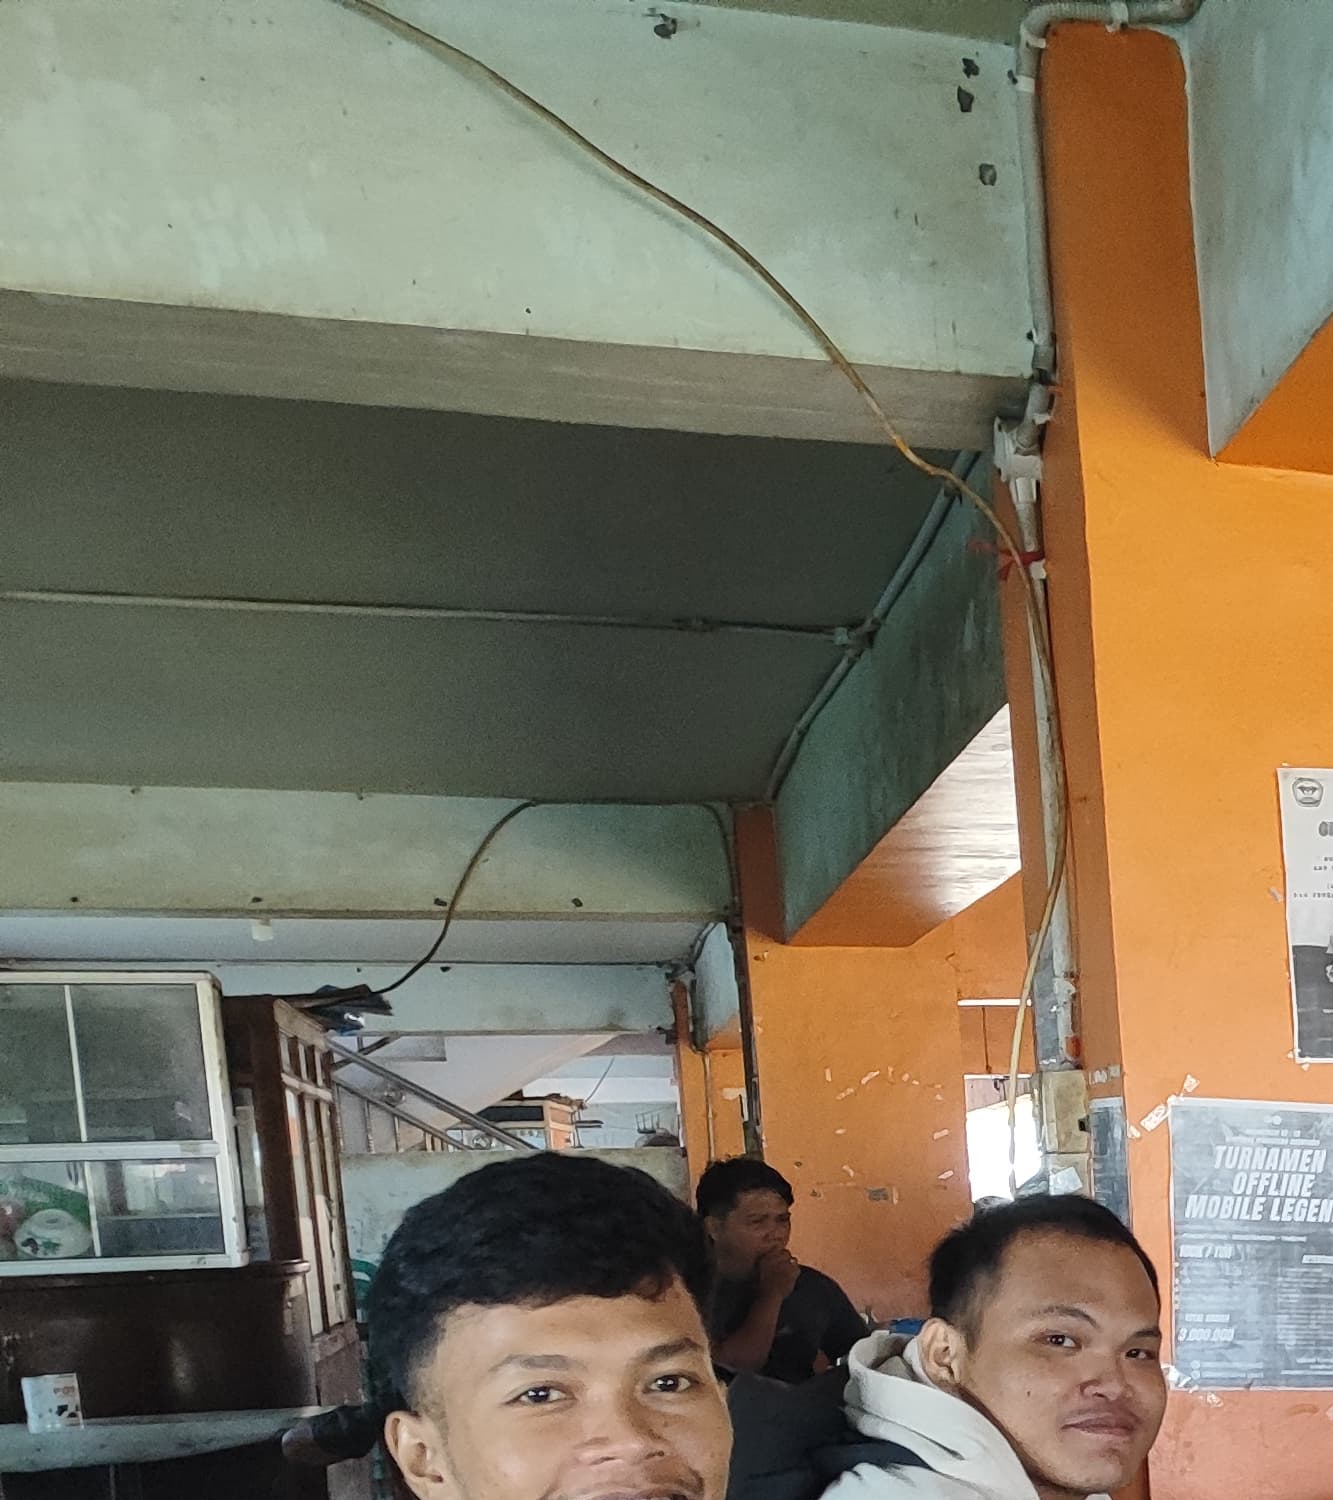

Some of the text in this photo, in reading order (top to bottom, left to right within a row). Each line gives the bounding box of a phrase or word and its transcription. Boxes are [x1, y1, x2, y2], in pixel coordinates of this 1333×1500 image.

[1214, 1145, 1327, 1174] TURNAMEN
[1232, 1171, 1316, 1197] OFFLINE
[1185, 1194, 1266, 1221] MOBILE
